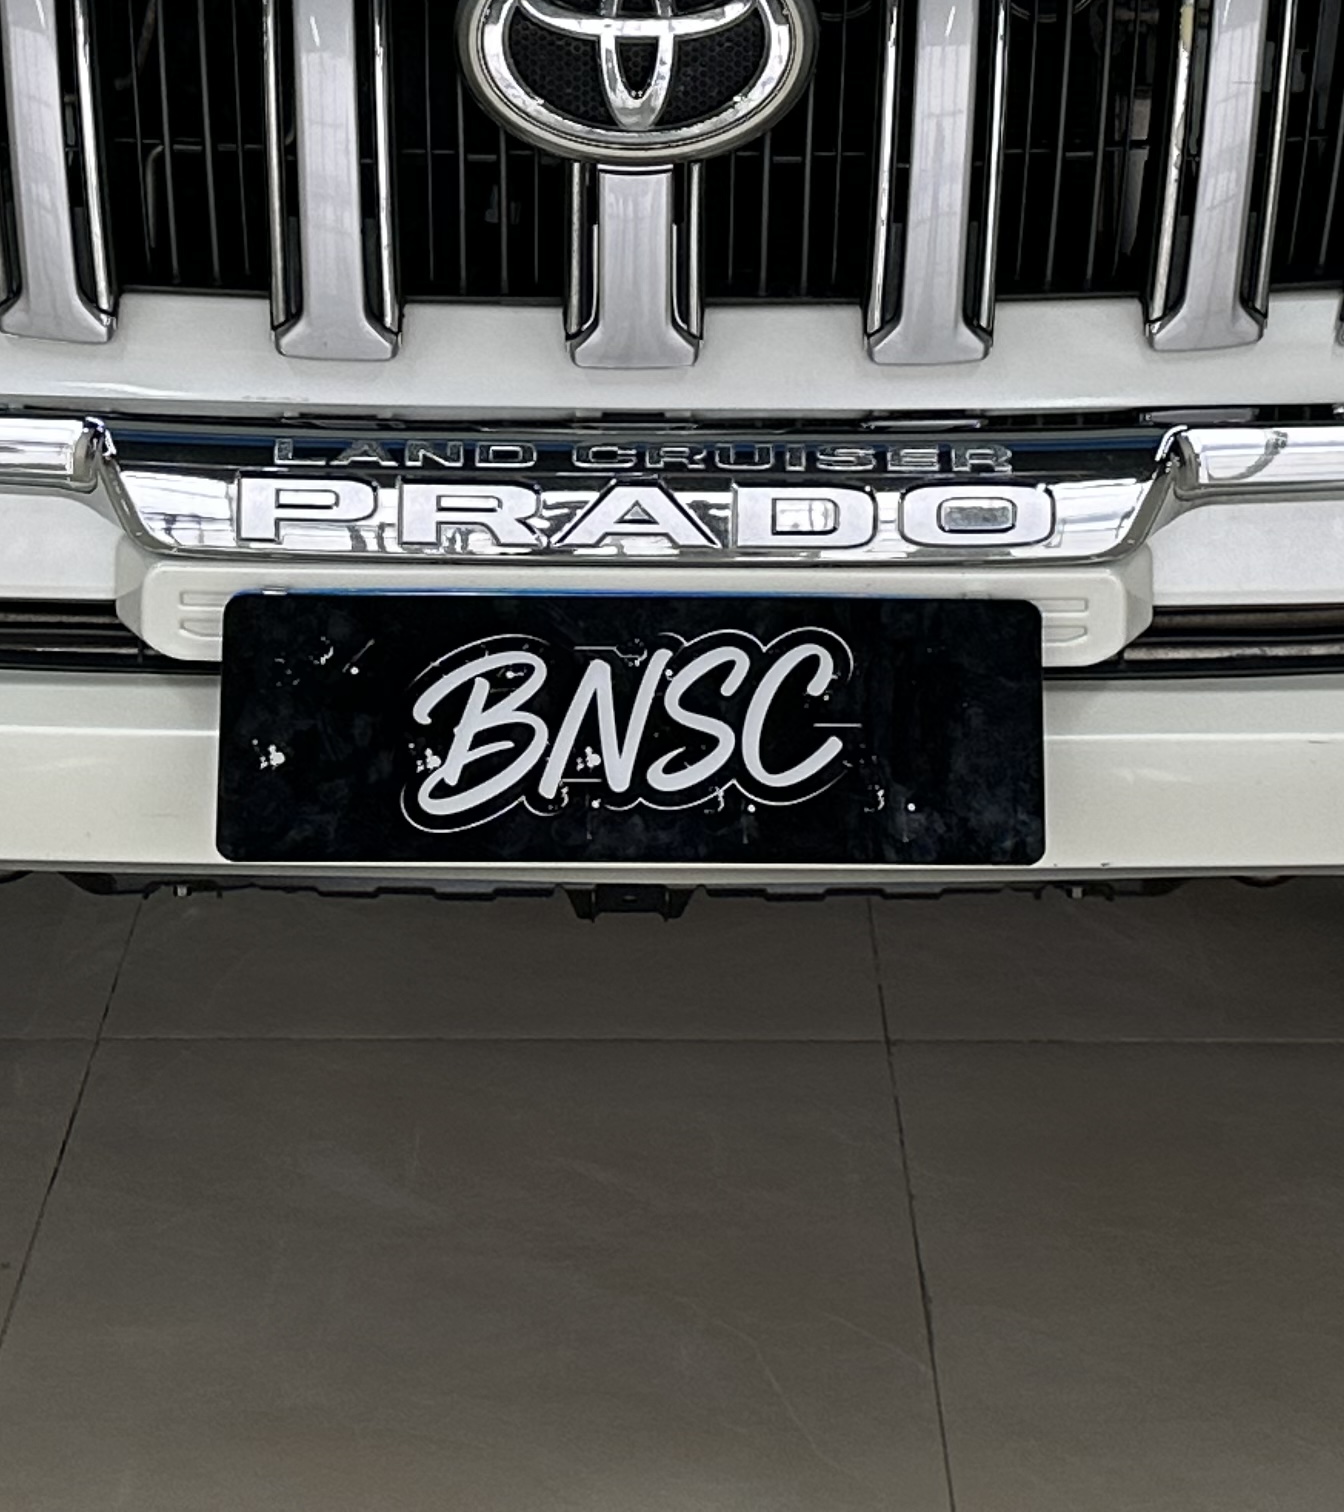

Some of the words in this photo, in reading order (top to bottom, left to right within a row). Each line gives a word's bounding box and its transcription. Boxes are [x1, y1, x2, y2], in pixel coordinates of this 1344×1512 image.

[273, 438, 538, 469] LAND
[570, 441, 1013, 474] CRUISER
[235, 473, 1056, 551] PRADO
[410, 640, 843, 816] BNSC
